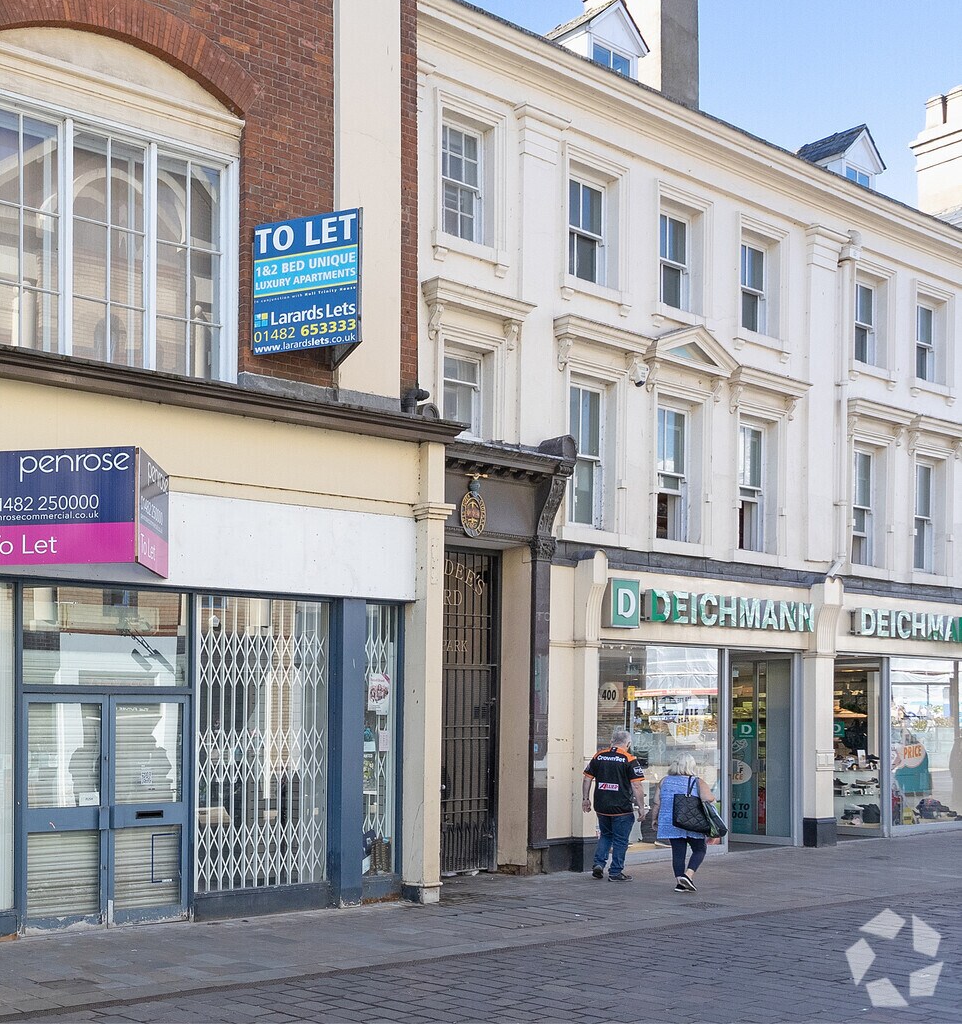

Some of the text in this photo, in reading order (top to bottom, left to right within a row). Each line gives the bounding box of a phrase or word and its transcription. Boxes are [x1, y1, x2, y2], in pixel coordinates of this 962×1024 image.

[255, 213, 356, 254] TO LET
[256, 252, 356, 277] 1&2 BED UNIQUE
[255, 267, 356, 291] LUXURY APARTMENTS
[271, 302, 356, 326] Larards Lets
[254, 319, 356, 343] 01482 653333
[255, 333, 356, 353] www.larardslets.co.uk
[20, 452, 130, 482] penrose
[147, 462, 169, 494] penrose
[37, 494, 99, 511] 250000
[22, 534, 57, 554] Let
[140, 533, 156, 561] To Let
[617, 588, 636, 619] D
[650, 588, 815, 633] DEICHMANN
[601, 689, 617, 701] 400
[904, 745, 922, 759] PRICE
